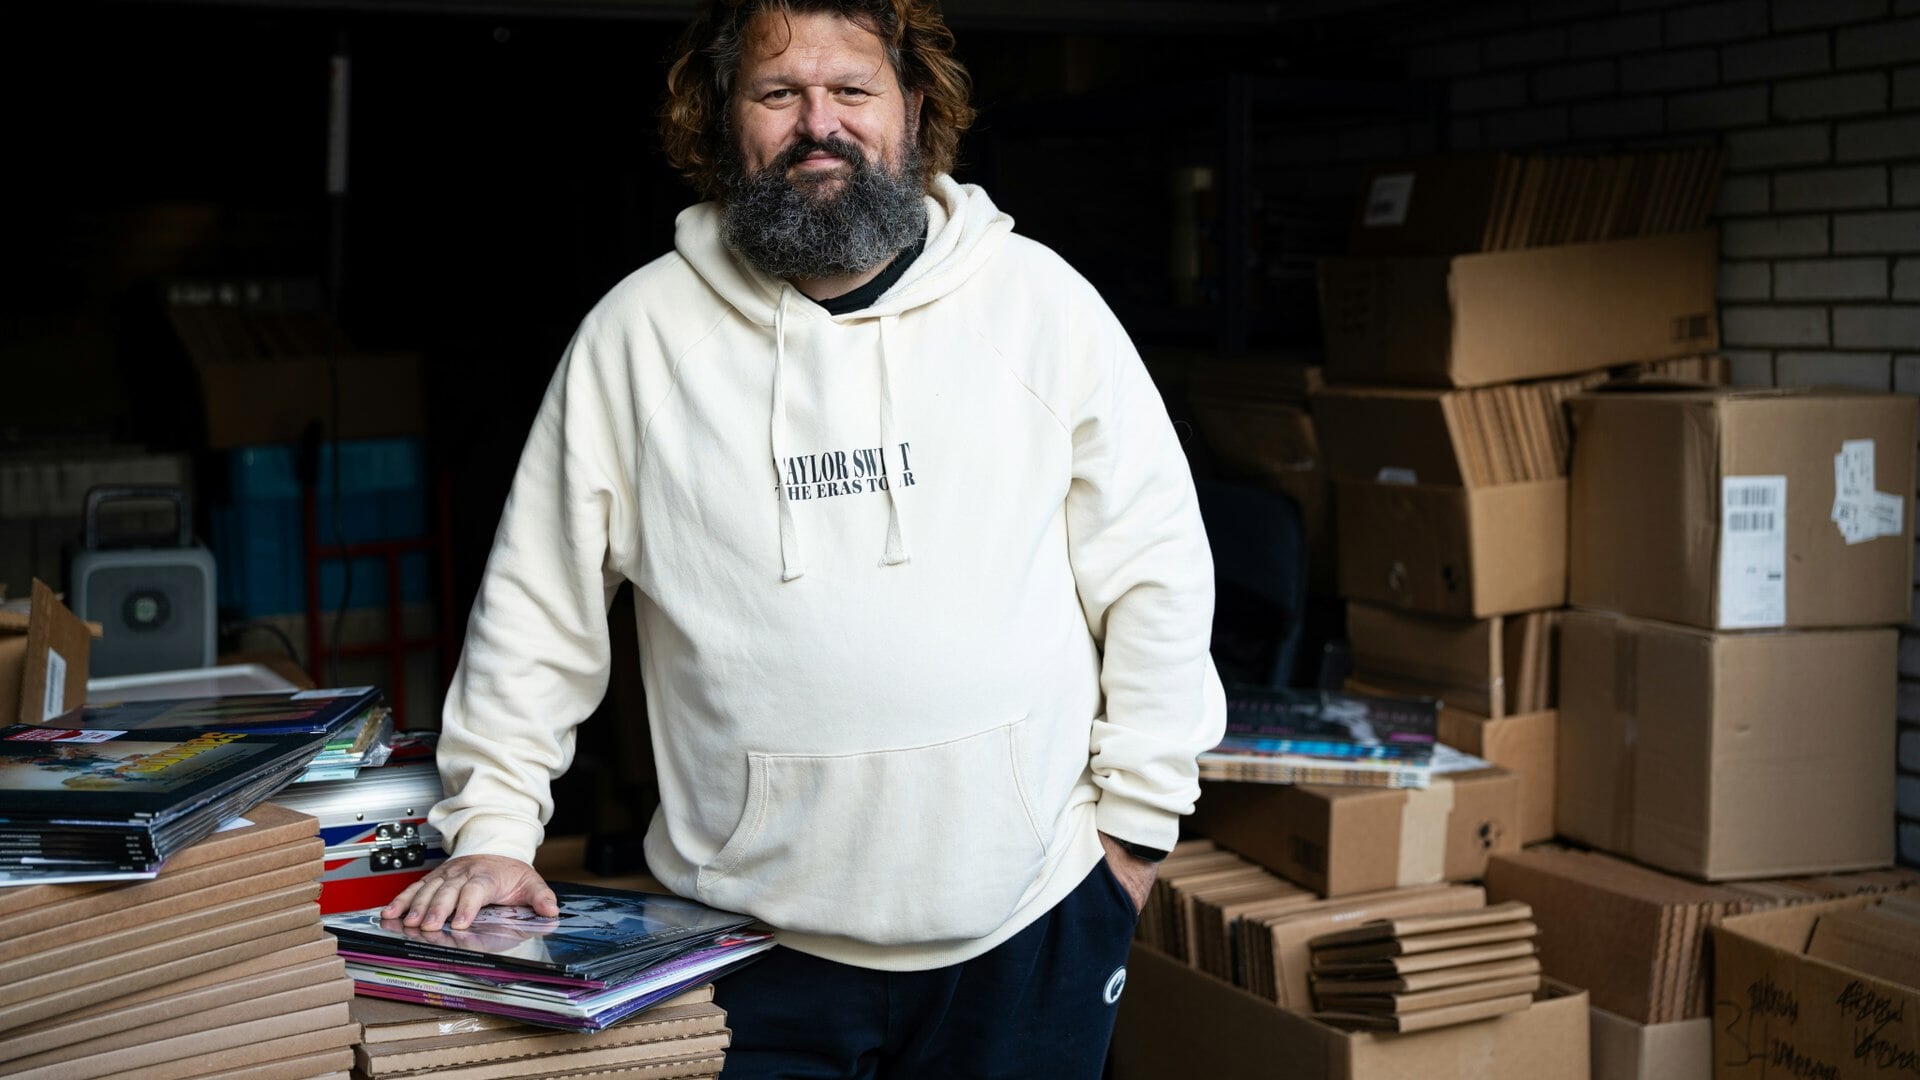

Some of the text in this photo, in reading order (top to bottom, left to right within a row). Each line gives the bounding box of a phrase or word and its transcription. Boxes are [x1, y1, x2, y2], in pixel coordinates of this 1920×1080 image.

[852, 442, 910, 479] SWIT
[817, 479, 863, 499] ERAS
[867, 472, 916, 493] TOR
